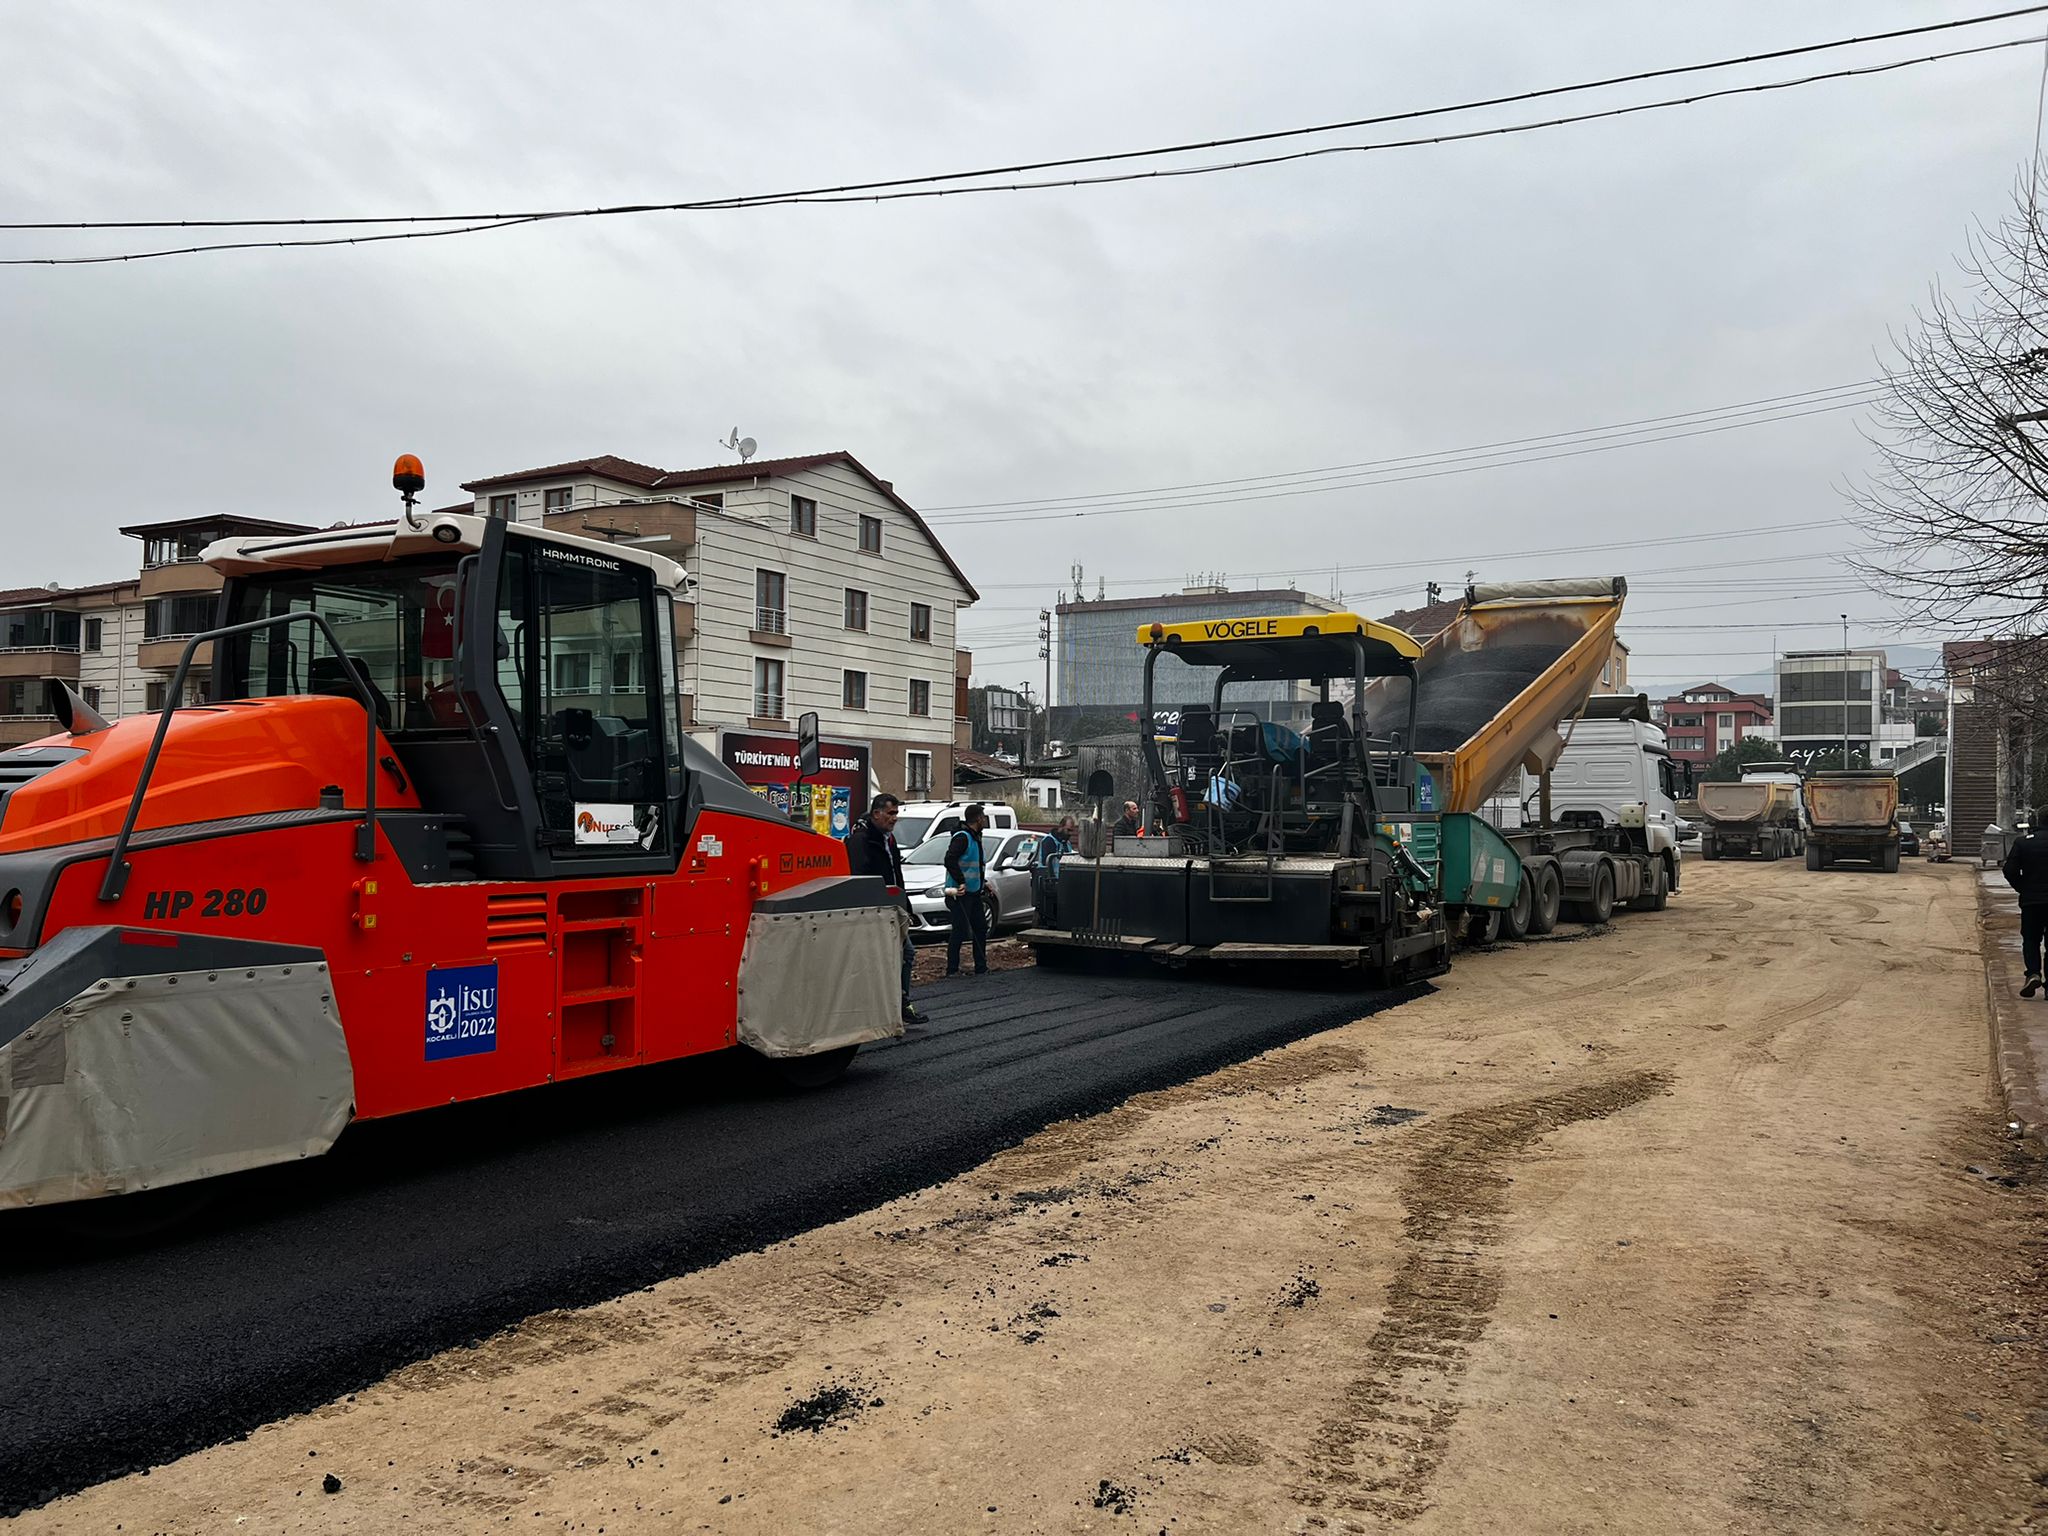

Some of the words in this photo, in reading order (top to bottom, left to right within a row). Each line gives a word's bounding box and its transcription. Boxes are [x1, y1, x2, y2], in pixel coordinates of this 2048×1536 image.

[542, 548, 620, 571] HAMMTRONIC
[1204, 620, 1278, 639] VÖGELE
[734, 750, 791, 767] TÜRKİYE'NİN
[819, 757, 860, 772] EZZETLERİ!
[796, 855, 832, 869] HAMM
[143, 890, 194, 919] HP
[201, 887, 268, 917] 280
[462, 985, 496, 1011] İSU
[460, 1016, 495, 1038] 2022
